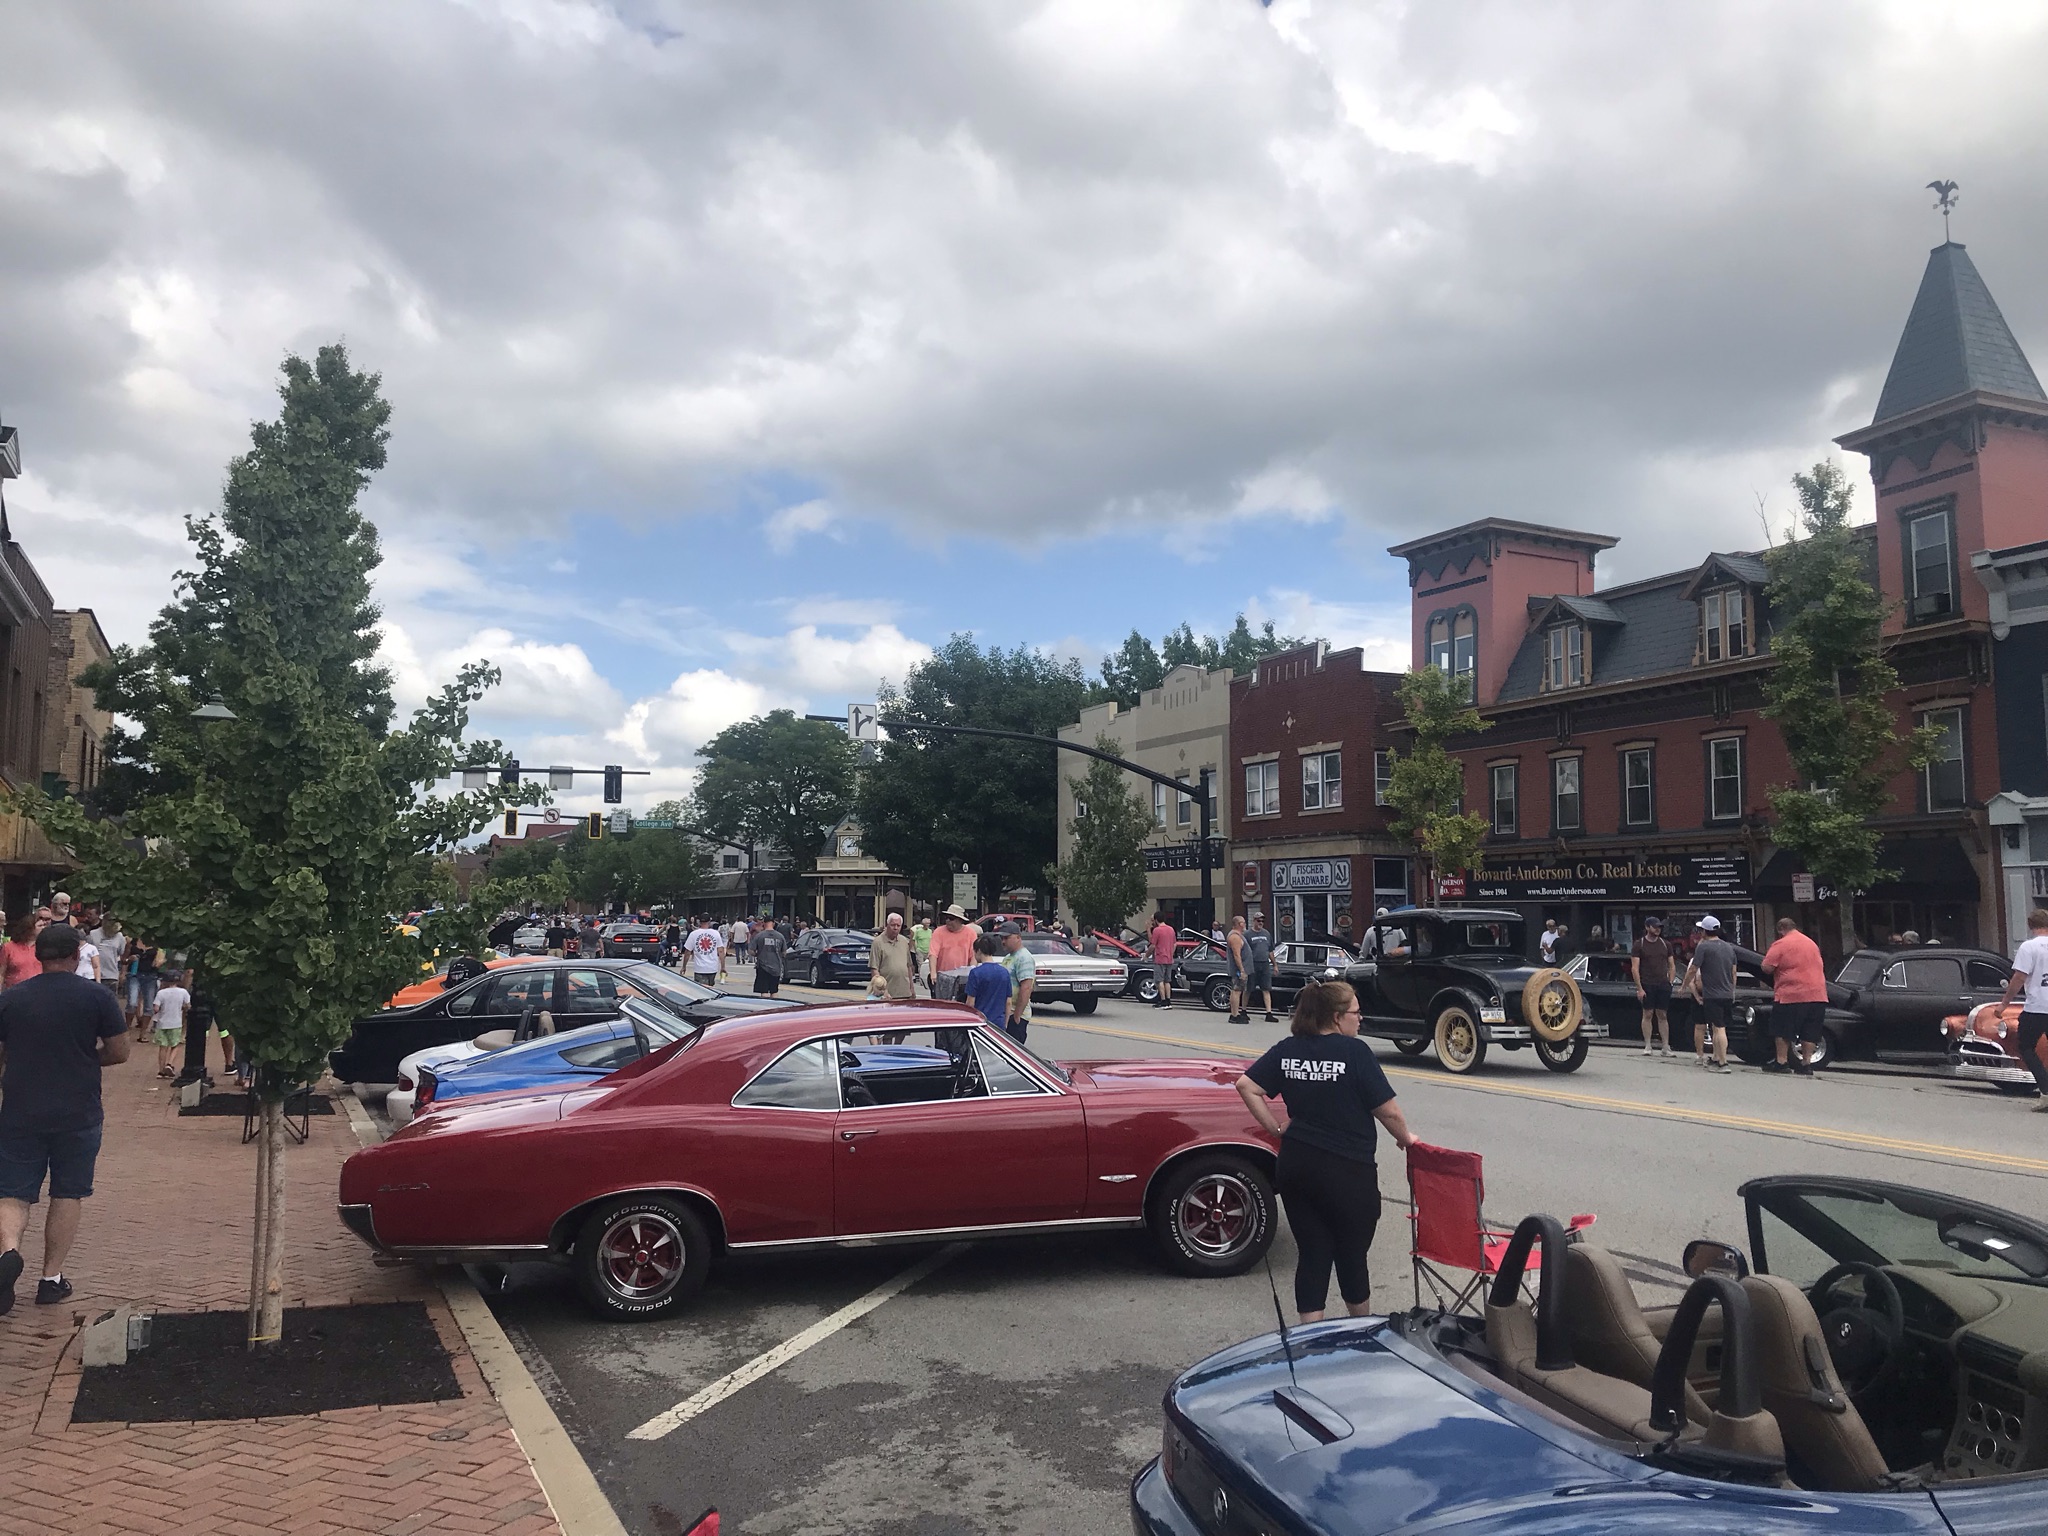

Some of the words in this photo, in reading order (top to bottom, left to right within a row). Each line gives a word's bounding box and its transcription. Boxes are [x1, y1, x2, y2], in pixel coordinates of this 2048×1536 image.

[635, 820, 658, 828] College
[1152, 857, 1199, 869] GALLE
[1296, 864, 1325, 875] FISCHER
[1472, 865, 1572, 882] Bovard-Anderson
[1576, 863, 1598, 879] Co.
[1601, 861, 1633, 879] Real
[1636, 861, 1682, 878] Estate
[1291, 875, 1330, 886] HARDWARE
[1478, 888, 1495, 896] Since
[1495, 888, 1508, 896] 1904
[1527, 887, 1607, 896] www.BovardAnderson.com
[1632, 885, 1676, 894] 724-774-5330
[1280, 1058, 1346, 1074] BEAVER
[1284, 1070, 1308, 1080] FIRE
[1309, 1072, 1340, 1082] DEPT
[1170, 1198, 1178, 1217] T/A
[603, 1204, 682, 1227] BFGoodrich
[1170, 1220, 1194, 1259] Radial
[606, 1296, 624, 1310] T/A
[627, 1295, 673, 1312] Radial
